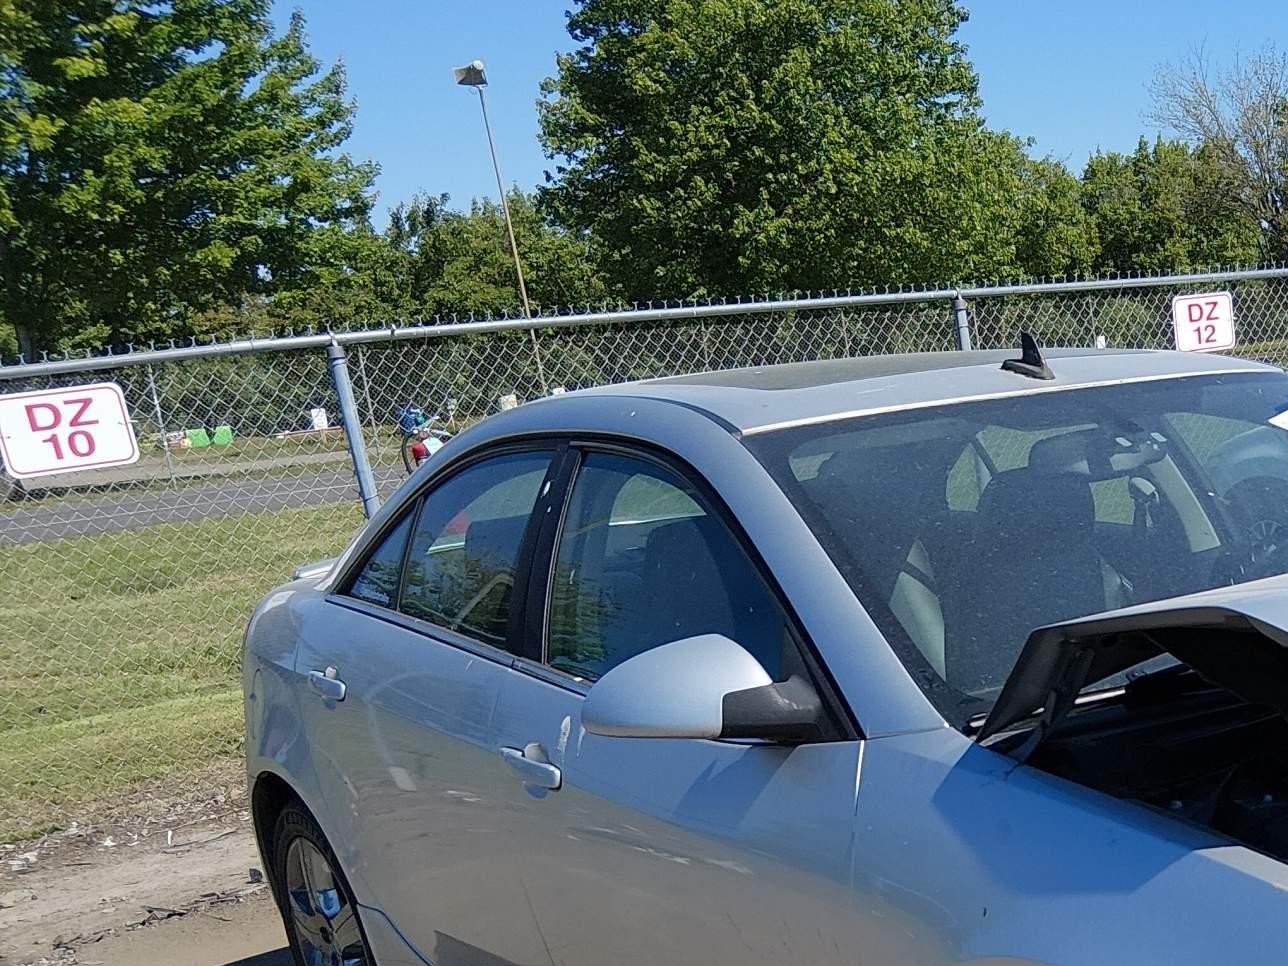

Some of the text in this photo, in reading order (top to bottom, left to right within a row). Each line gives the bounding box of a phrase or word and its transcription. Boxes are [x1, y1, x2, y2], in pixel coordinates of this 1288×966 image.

[1187, 301, 1220, 322] DZ
[1193, 325, 1217, 344] 12
[24, 398, 99, 432] DZ
[42, 430, 95, 460] 10
